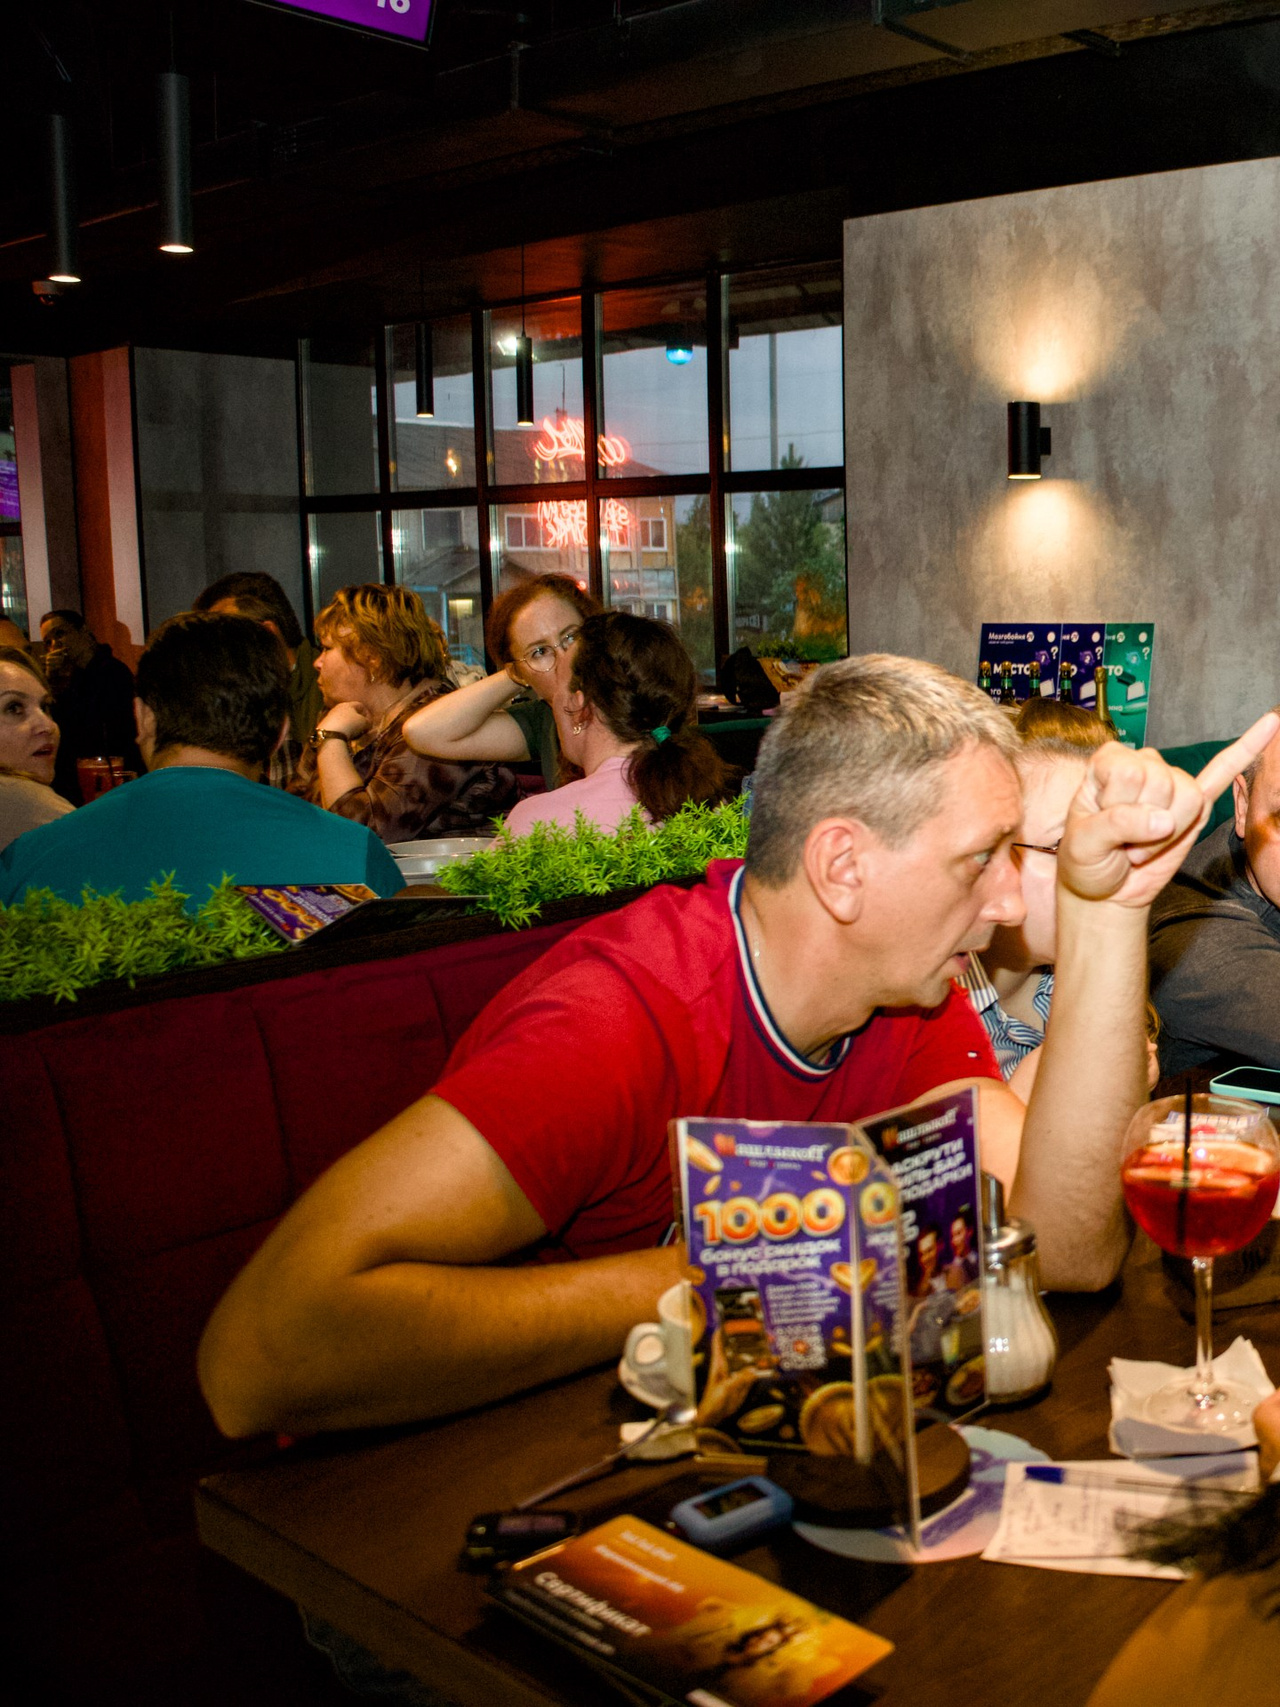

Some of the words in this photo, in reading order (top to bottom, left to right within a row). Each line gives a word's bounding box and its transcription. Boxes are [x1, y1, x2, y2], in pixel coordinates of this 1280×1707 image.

[988, 632, 1026, 640] Мозгобойня
[993, 663, 1030, 675] МСТО
[890, 1138, 964, 1175] АСКРУТИ
[694, 1187, 846, 1246] 1000
[716, 1263, 730, 1278] в
[731, 1254, 822, 1277] подарок
